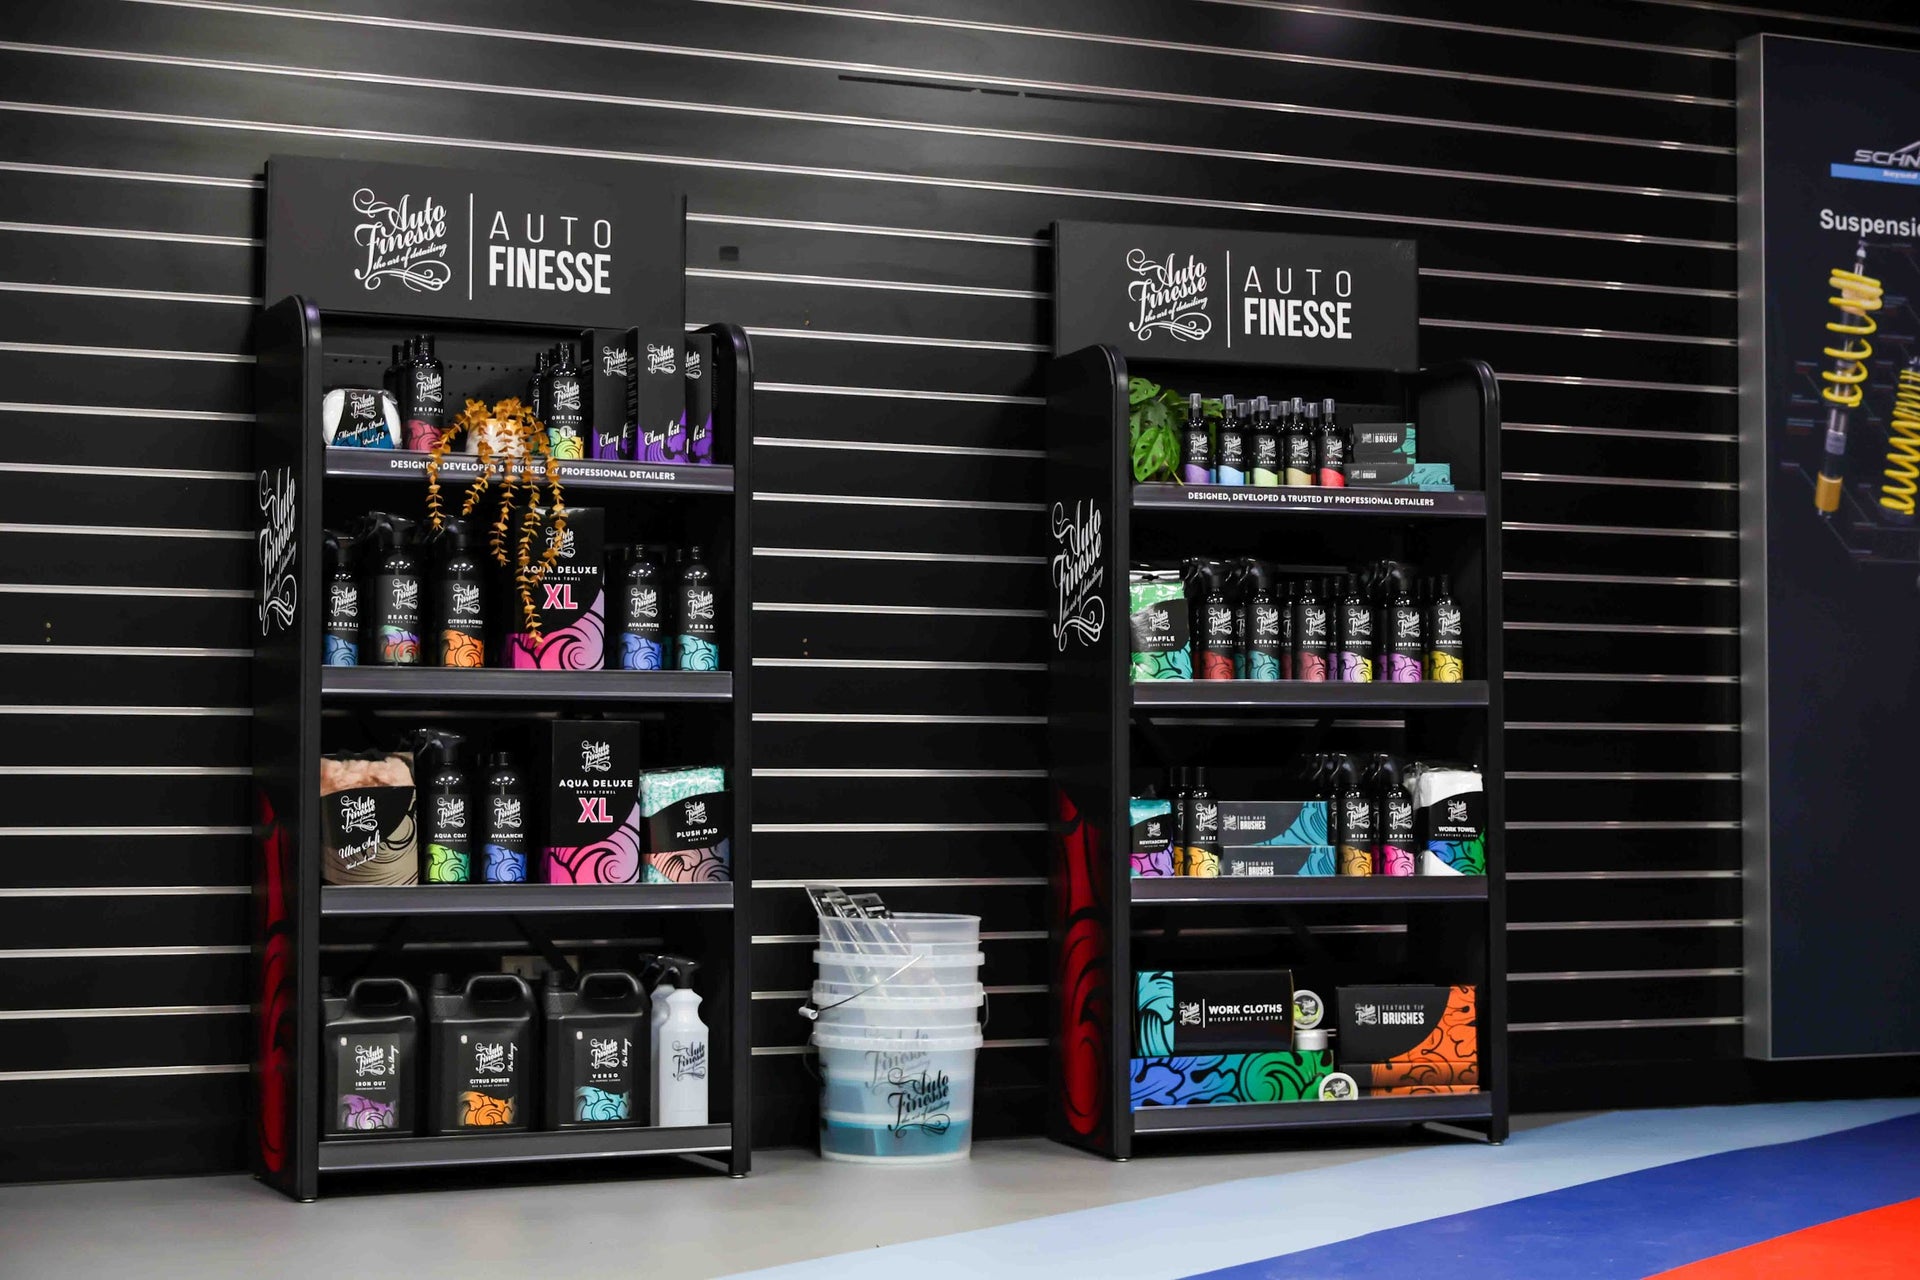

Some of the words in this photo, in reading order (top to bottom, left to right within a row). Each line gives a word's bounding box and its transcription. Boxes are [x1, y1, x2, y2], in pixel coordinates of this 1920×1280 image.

[372, 191, 446, 234] Auto
[1820, 208, 1920, 237] Suspensi
[489, 211, 612, 249] AUTO
[355, 222, 447, 279] Finesse
[489, 245, 612, 295] FINESSE
[1144, 251, 1206, 289] Auto
[1244, 266, 1352, 297] AUTO
[1128, 277, 1207, 332] Finesse
[1244, 297, 1352, 340] FINESSE
[600, 432, 619, 451] Clay
[644, 430, 665, 450] Clay
[668, 420, 680, 437] kit
[693, 425, 706, 441] kit
[1374, 435, 1398, 443] BRUSH
[498, 464, 505, 472] &
[561, 467, 628, 479] PROFESSIONAL
[630, 470, 676, 481] DETAILERS
[1188, 491, 1230, 502] DESIGNED,
[1232, 493, 1278, 502] DEVELOPED
[1281, 494, 1287, 502] &
[1288, 495, 1322, 504] TRUSTED
[1324, 496, 1334, 504] BY
[1335, 496, 1393, 505] PROFESSIONAL
[1395, 498, 1434, 506] DETAILERS
[1061, 498, 1102, 557] Auto
[557, 566, 598, 575] DELUXE
[542, 583, 579, 610] XL
[1053, 549, 1102, 638] Finesse
[558, 779, 589, 788] AQUA
[593, 779, 633, 788] DELUXE
[577, 797, 614, 823] XL
[676, 829, 701, 838] PLUSH
[702, 827, 718, 835] PAD
[1240, 820, 1266, 830] BRUSHES
[1248, 866, 1274, 876] BRUSHES
[1208, 1005, 1241, 1015] WORK
[1242, 1003, 1283, 1014] CLOTHS
[1382, 1011, 1425, 1025] BRUSHES
[888, 1086, 949, 1132] Finesse
